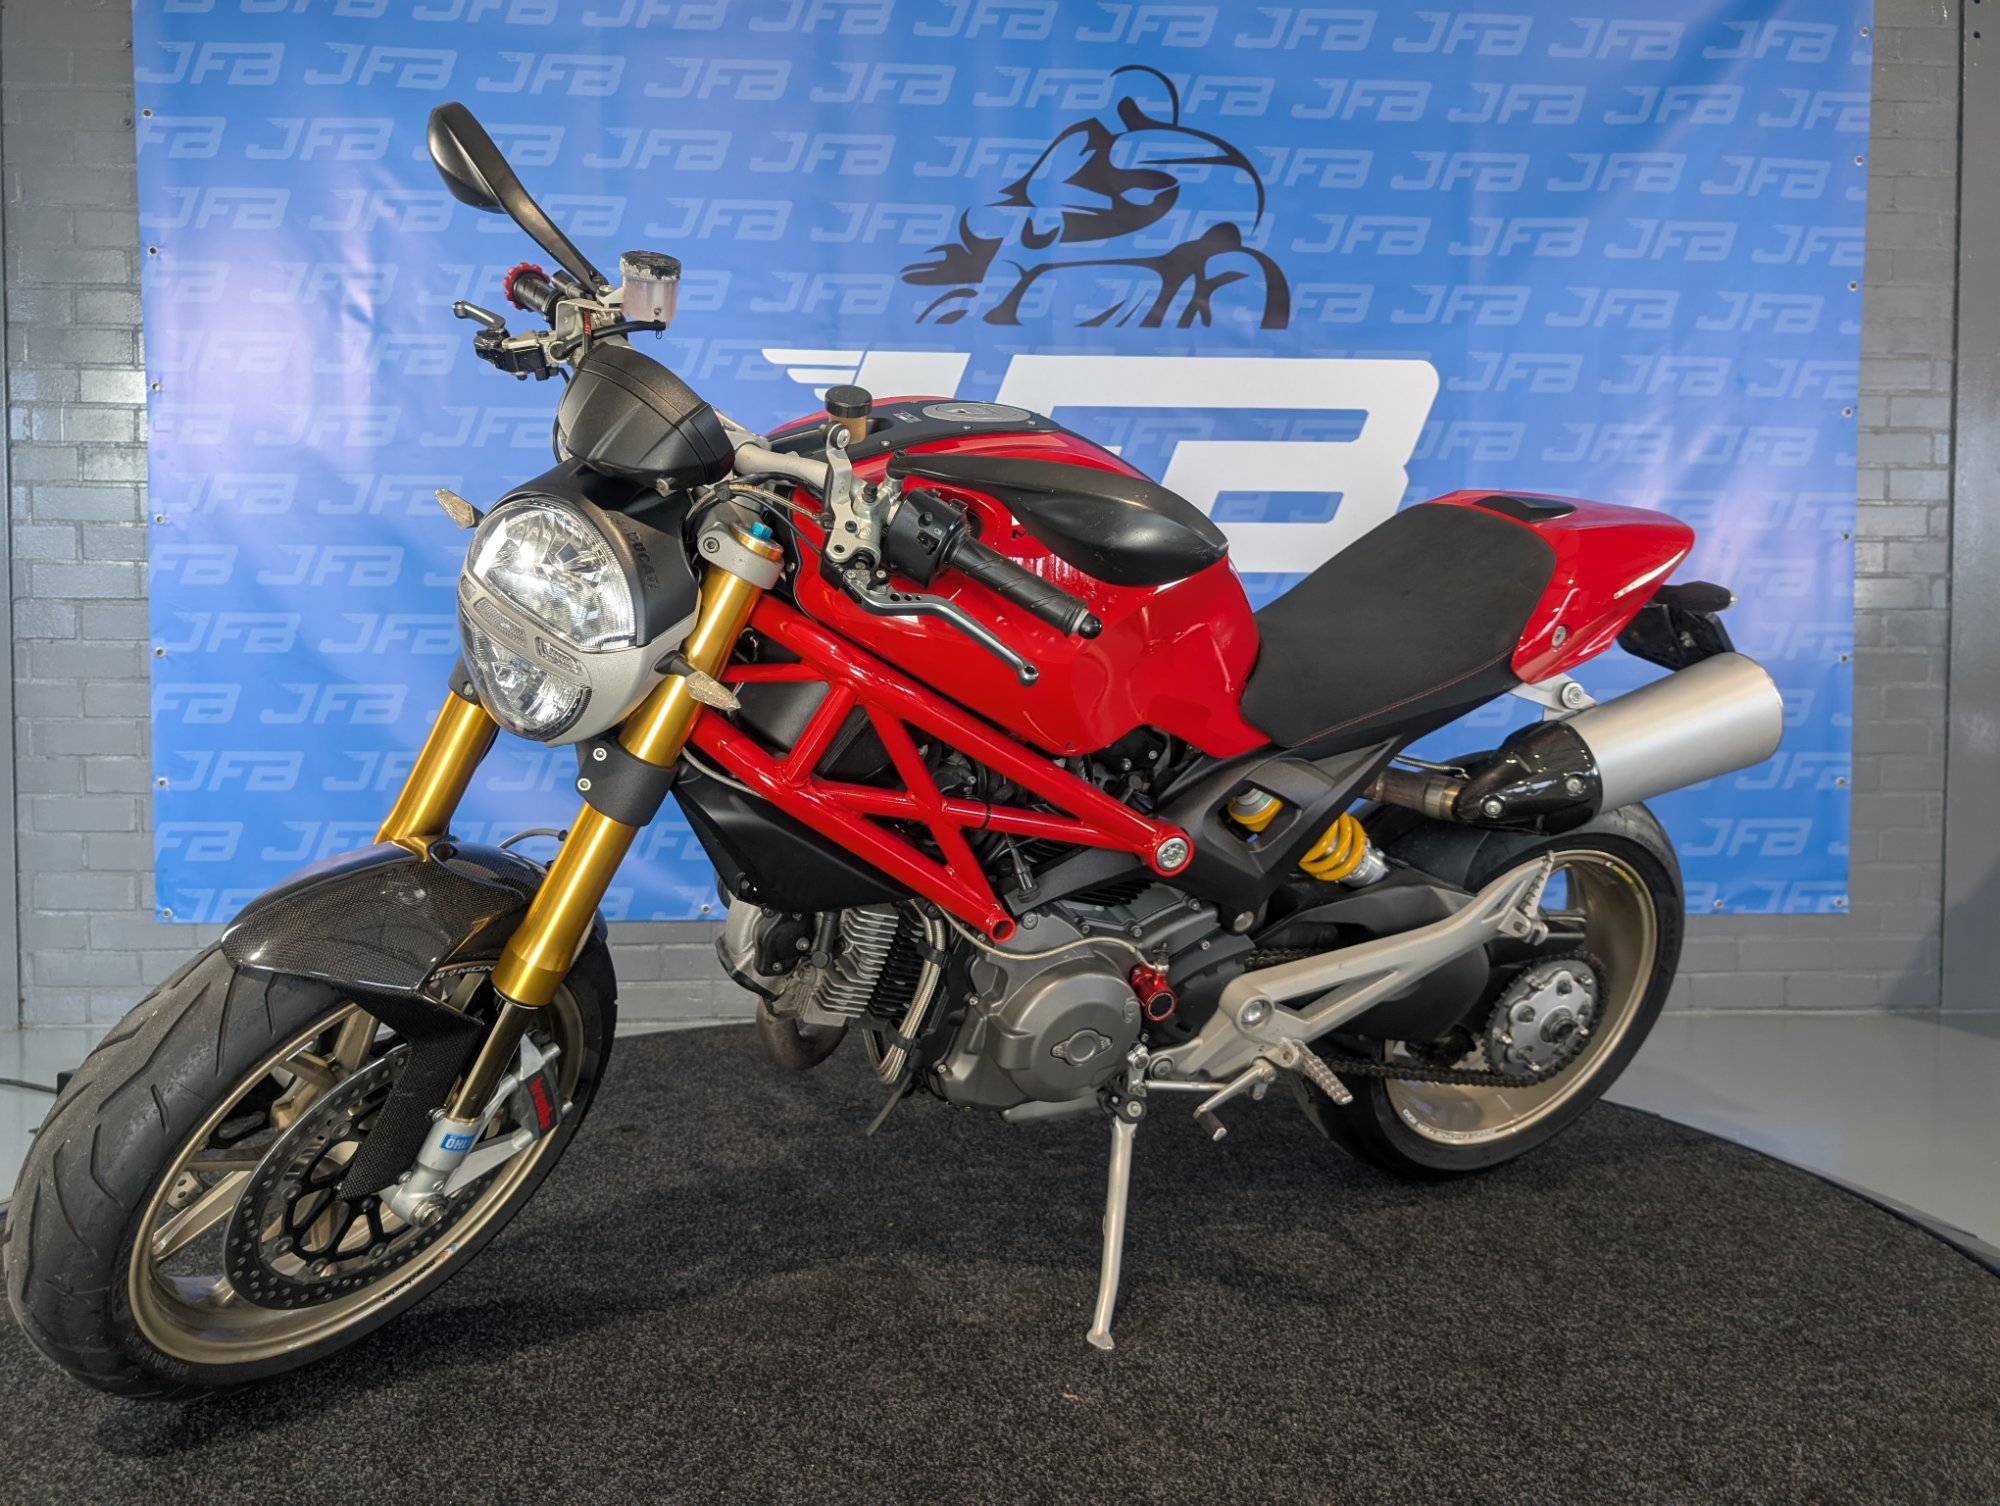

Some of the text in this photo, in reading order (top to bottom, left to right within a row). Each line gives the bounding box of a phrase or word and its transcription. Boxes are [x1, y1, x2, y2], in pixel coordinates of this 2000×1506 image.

[1075, 2, 1218, 48] JFB
[1234, 6, 1377, 51] JFB
[1393, 11, 1534, 56] JFB
[1548, 17, 1685, 61] JFB
[1702, 20, 1838, 63] JFB
[134, 41, 286, 85] JFB
[304, 42, 457, 90] JFB
[475, 51, 627, 96] JFB
[644, 57, 793, 100] JFB
[809, 61, 956, 105] JFB
[972, 66, 1116, 109] JFB
[1290, 78, 1433, 121] JFB
[1447, 82, 1587, 124] JFB
[1603, 84, 1744, 124] JFB
[136, 116, 226, 159] FB
[245, 118, 394, 160] JFB
[582, 127, 733, 171] JFB
[749, 131, 896, 175] JFB
[1390, 151, 1530, 191] JFB
[1547, 153, 1687, 192] JFB
[1700, 155, 1831, 199] JFB
[139, 186, 291, 230] JFB
[644, 197, 793, 241] JFB
[809, 202, 956, 244] JFB
[1291, 213, 1432, 255] JFB
[1448, 216, 1589, 256] JFB
[1604, 218, 1738, 260] JFB
[250, 262, 398, 304] JFB
[750, 272, 896, 314] JFB
[1391, 284, 1532, 325] JFB
[1545, 286, 1680, 328] JFB
[1695, 290, 1825, 333] JFB
[1446, 351, 1584, 392] JFB
[1599, 354, 1730, 396] JFB
[253, 404, 401, 446] JFB
[1541, 422, 1674, 463] JFB
[150, 544, 238, 585] FB
[256, 545, 404, 586] JFB
[153, 683, 408, 724] FB JFB
[155, 821, 244, 861] FB
[1680, 818, 1813, 857] JFB
